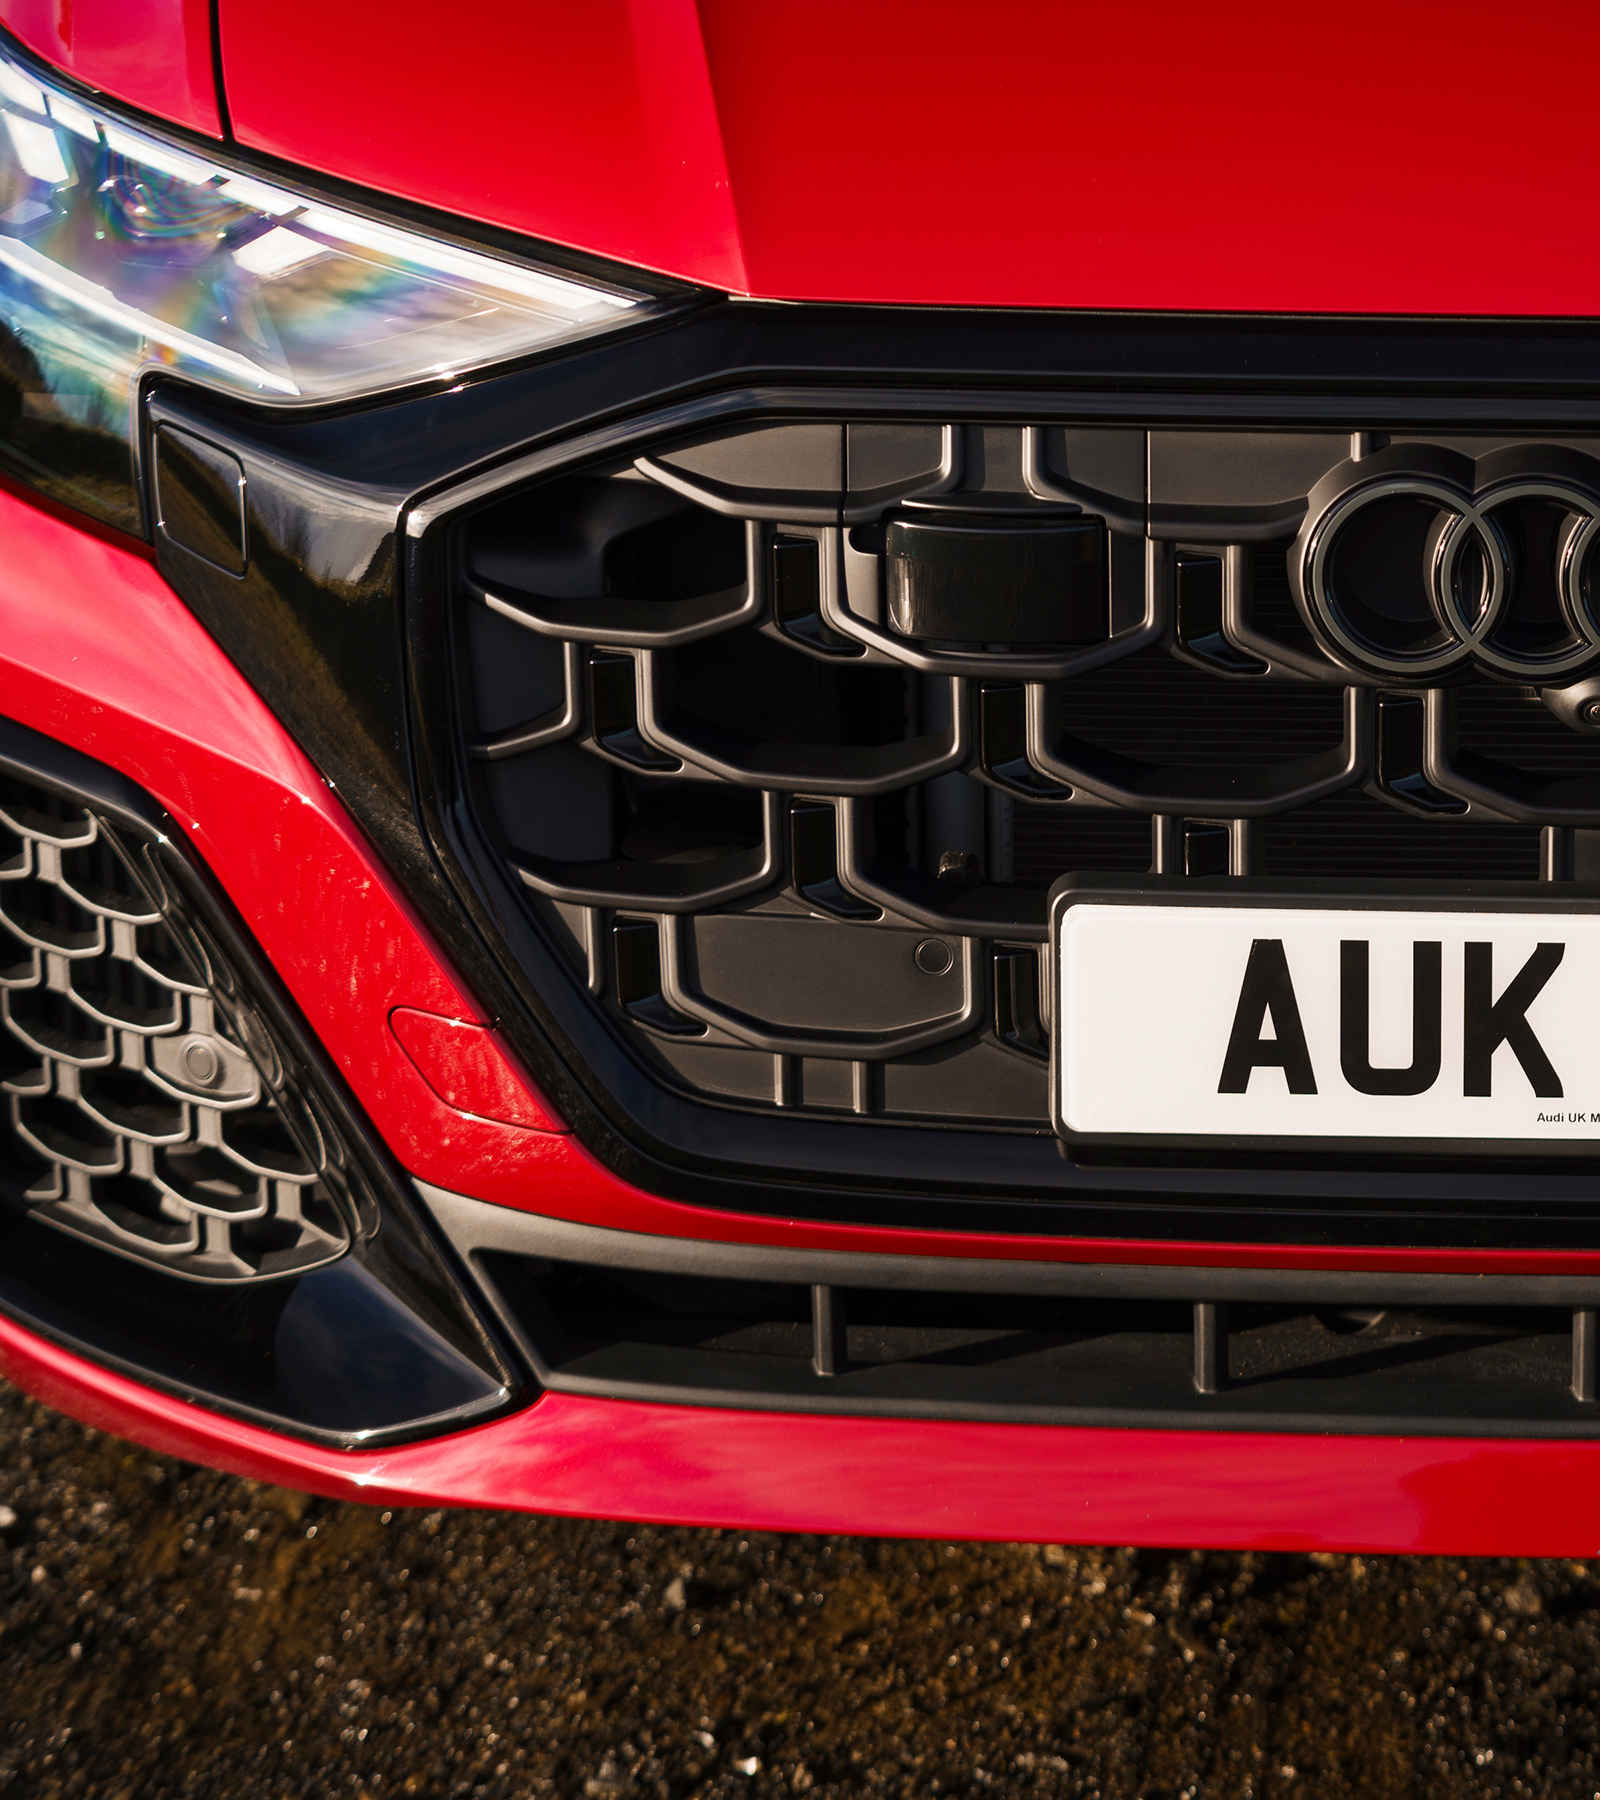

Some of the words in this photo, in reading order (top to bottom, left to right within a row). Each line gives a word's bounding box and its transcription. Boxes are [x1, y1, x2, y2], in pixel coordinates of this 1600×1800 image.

[1217, 938, 1566, 1099] AUK
[1536, 1112, 1565, 1123] Audi
[1568, 1112, 1587, 1123] UK
